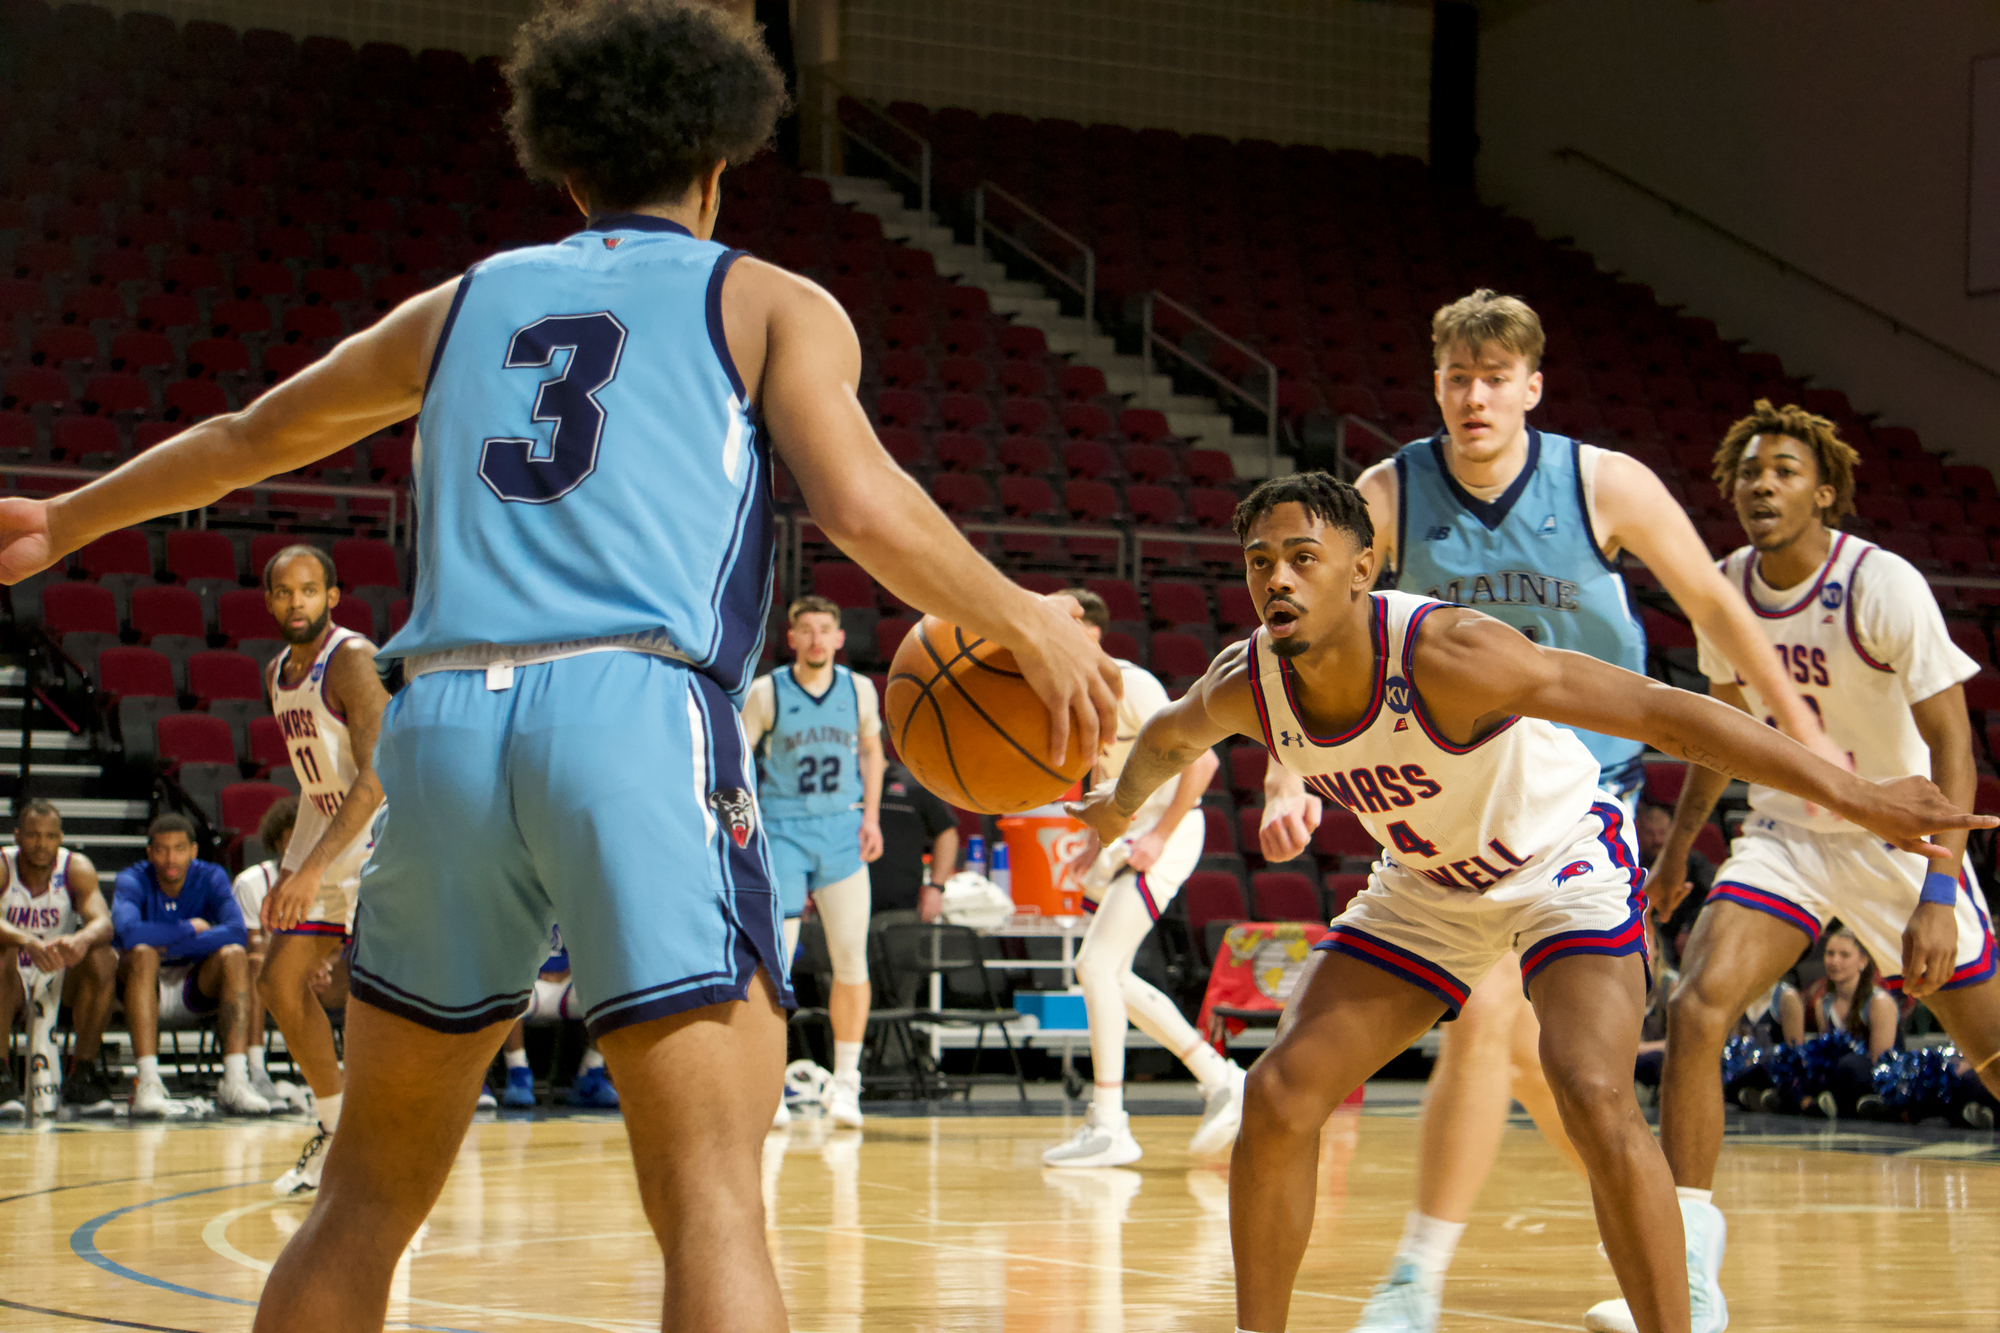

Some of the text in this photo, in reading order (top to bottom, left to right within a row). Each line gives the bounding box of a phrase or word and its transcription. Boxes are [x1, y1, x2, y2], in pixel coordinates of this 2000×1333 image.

[478, 310, 629, 505] 3
[1385, 684, 1409, 707] KV
[295, 745, 323, 784] 11
[797, 755, 840, 794] 22
[1386, 820, 1441, 858] 4
[1415, 838, 1534, 890] WELL
[6, 904, 61, 929] UMASS
